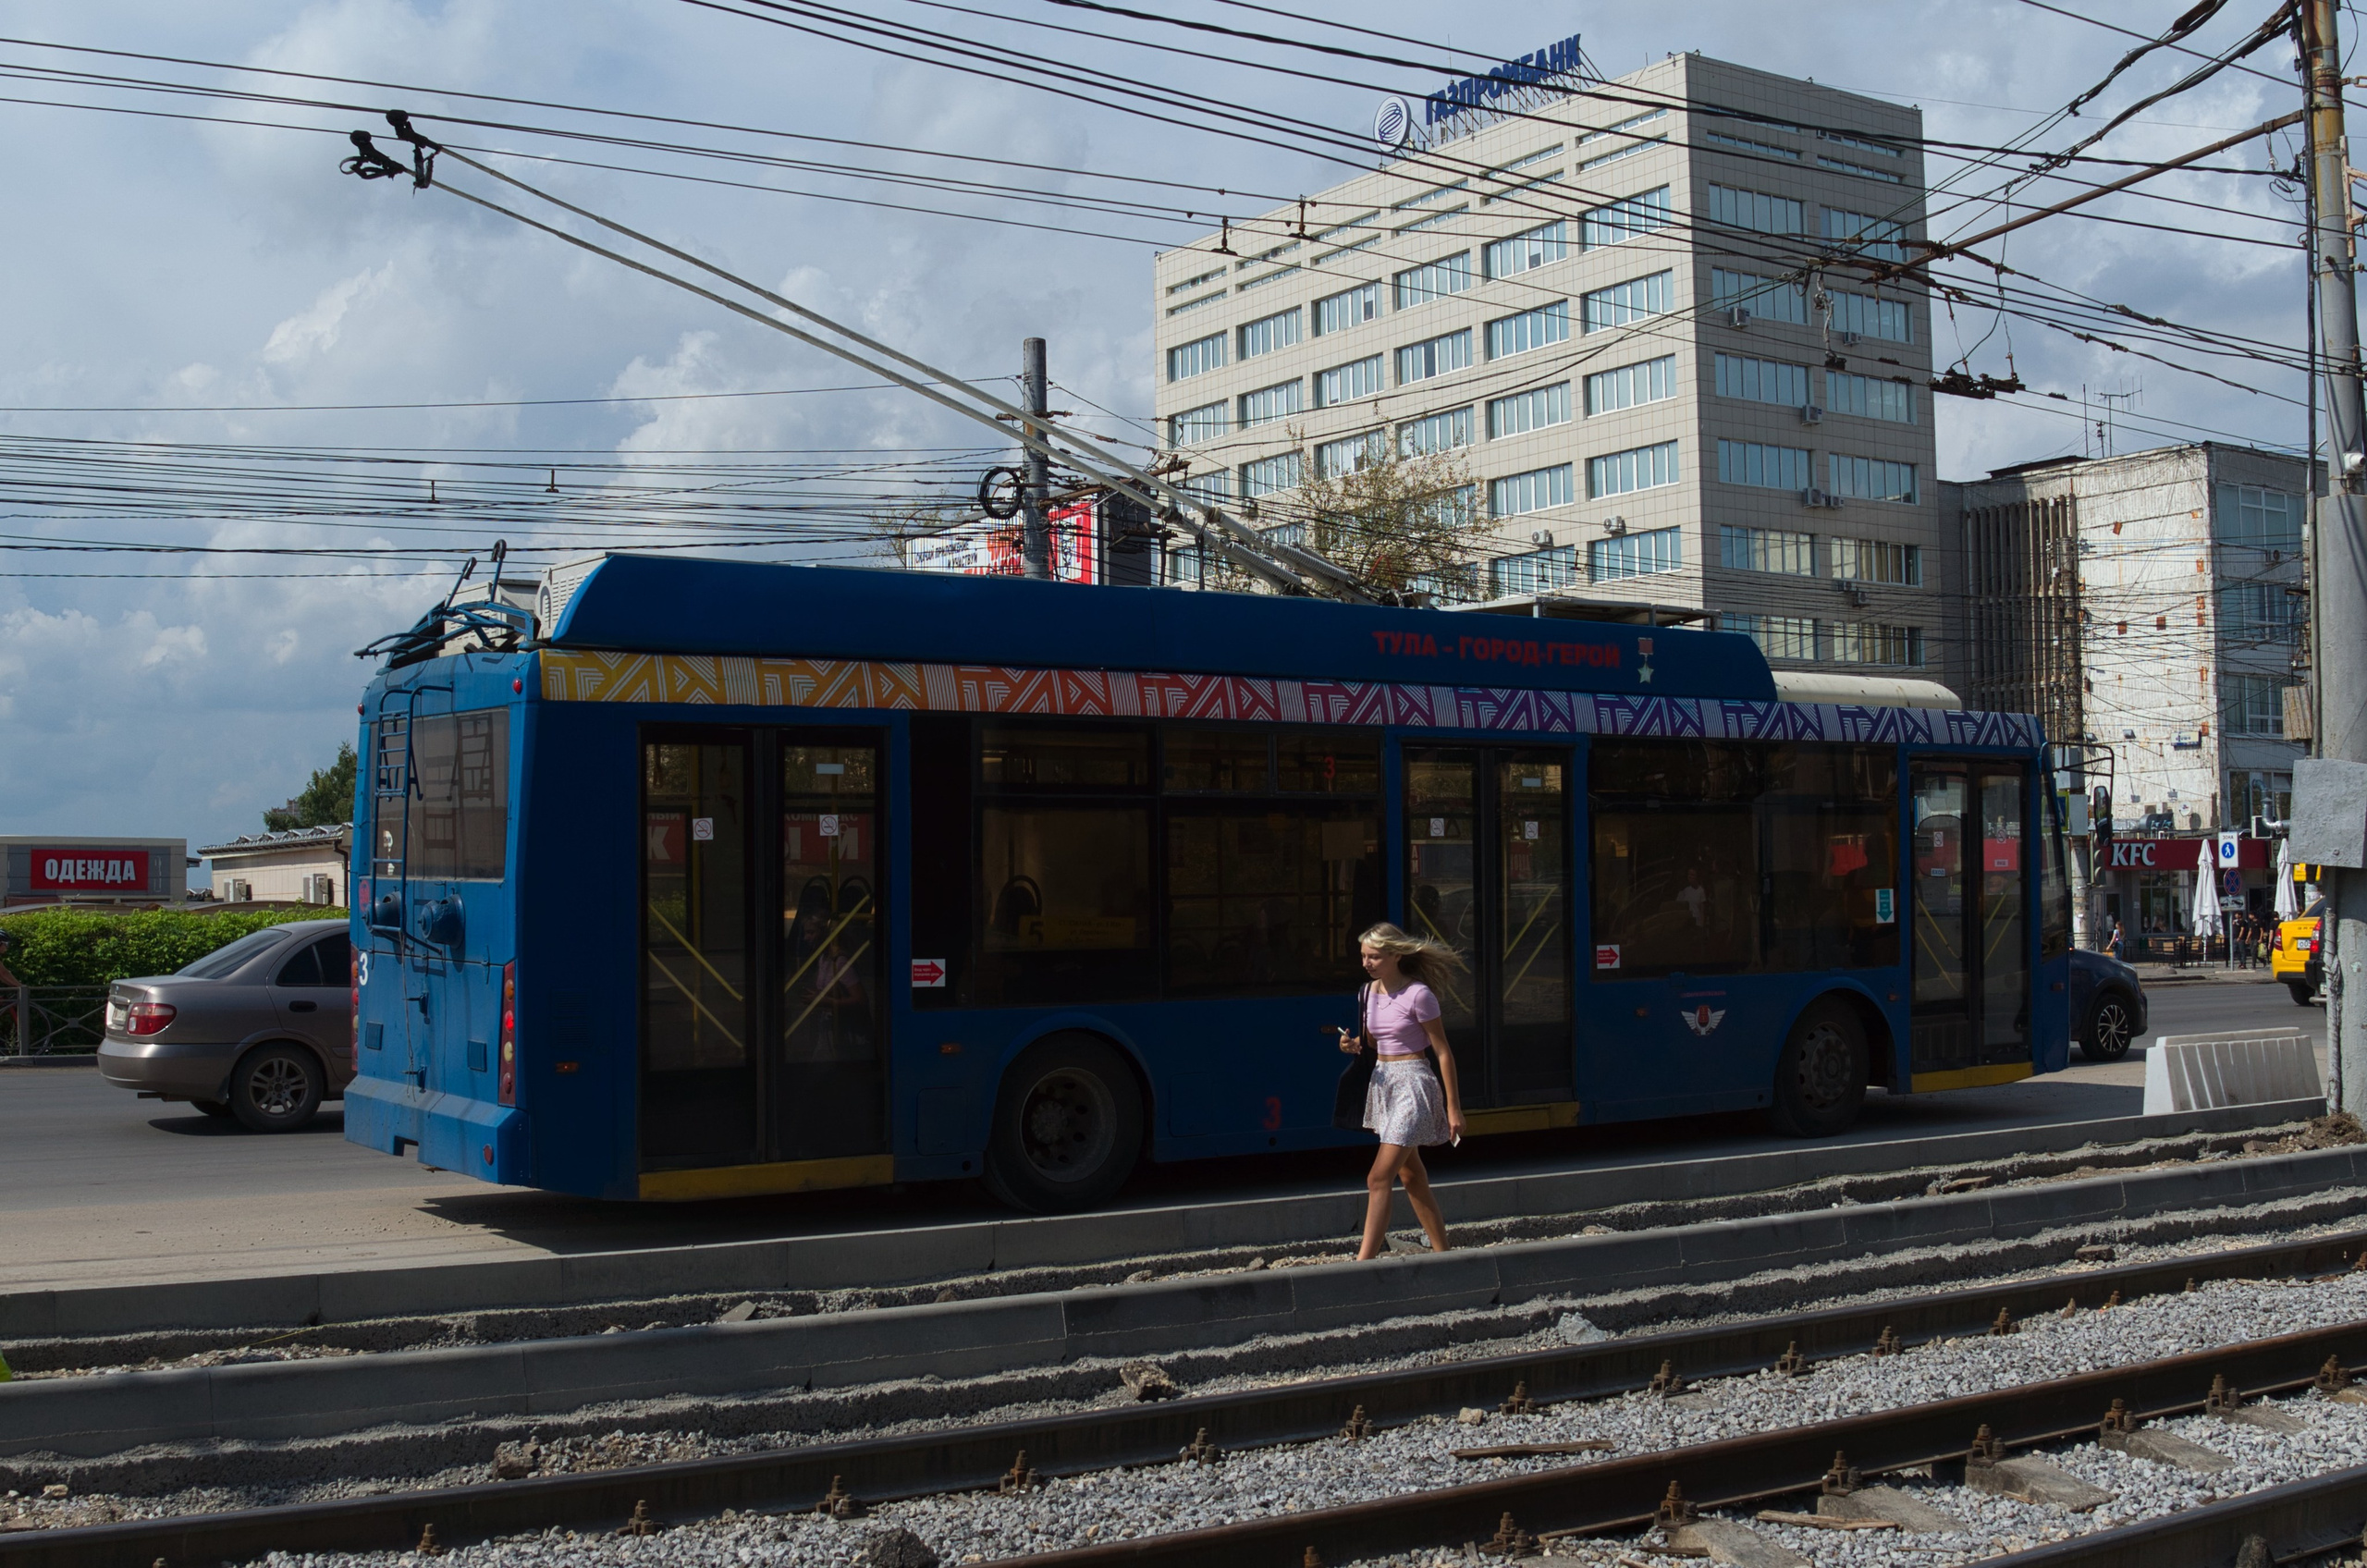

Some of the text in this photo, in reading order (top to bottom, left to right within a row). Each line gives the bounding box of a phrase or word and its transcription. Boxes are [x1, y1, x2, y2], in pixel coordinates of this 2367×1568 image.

[1426, 33, 1581, 125] ГАЗПРОМБАНК
[1371, 631, 1439, 658] ТУЛА
[2110, 842, 2156, 866] KFC
[44, 858, 136, 884] ОДЕЖДА
[359, 952, 369, 986] 3
[1262, 1095, 1282, 1132] 3
